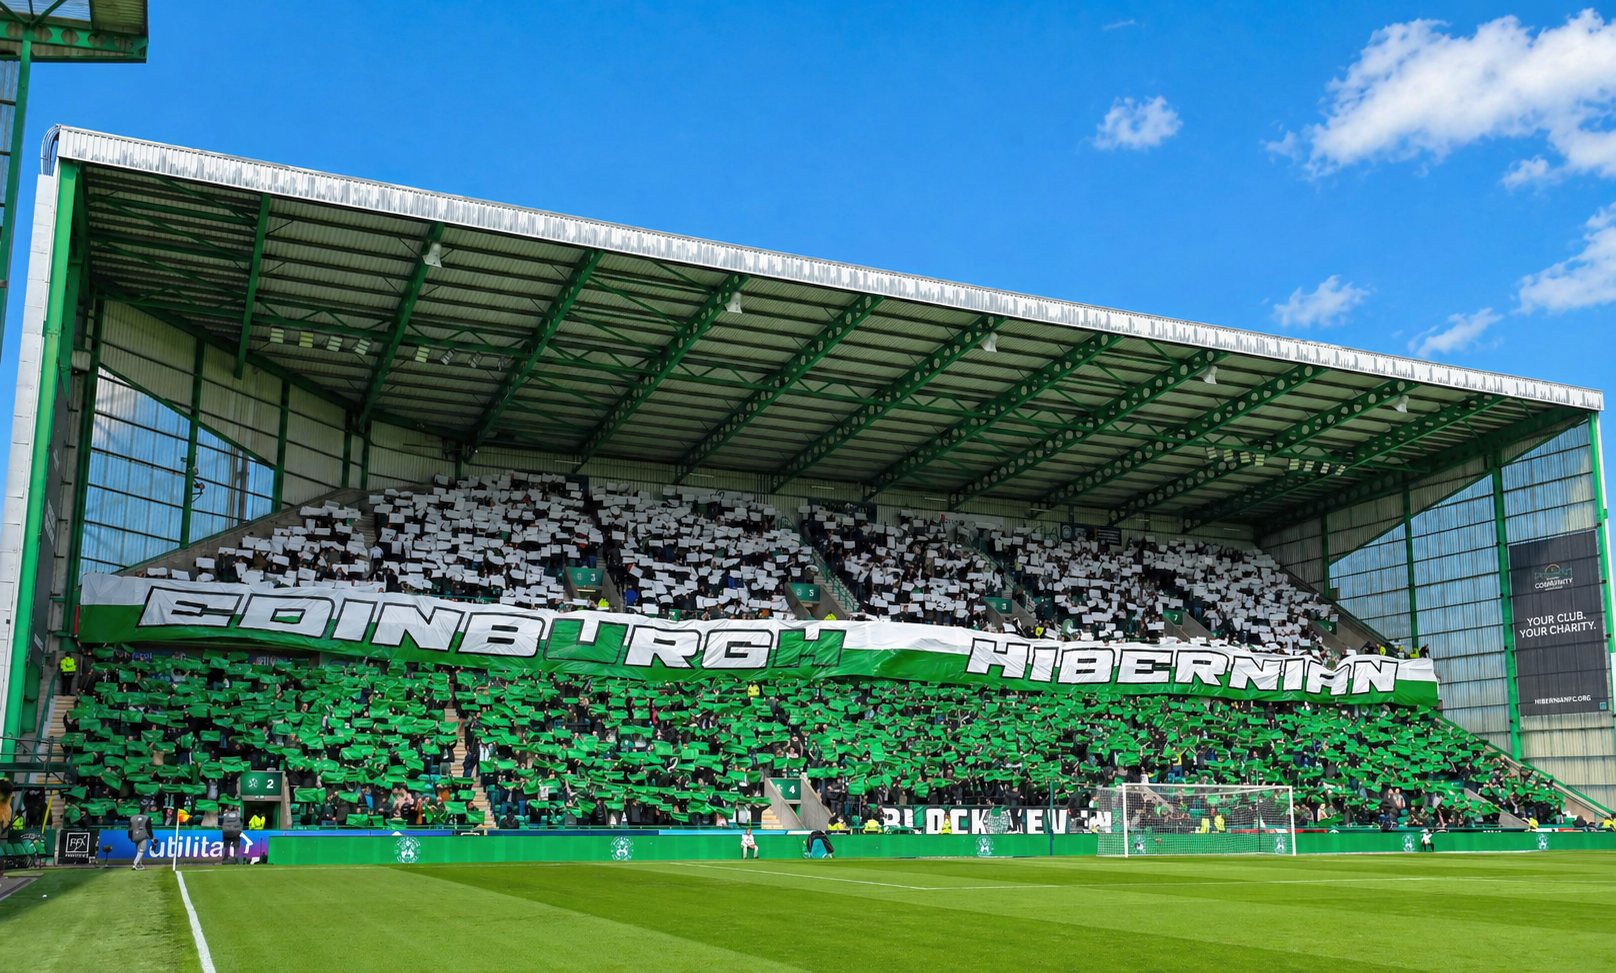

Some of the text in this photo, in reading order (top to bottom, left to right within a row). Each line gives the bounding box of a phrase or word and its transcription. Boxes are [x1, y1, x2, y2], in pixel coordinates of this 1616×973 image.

[809, 589, 814, 597] 5
[1527, 611, 1587, 627] YOUR CLUB.
[136, 586, 847, 670] EDINBURGH
[1520, 621, 1597, 639] YOUR CHARITY.
[964, 637, 1399, 696] HIBERNIAN
[266, 779, 274, 789] 2
[789, 785, 795, 794] 4
